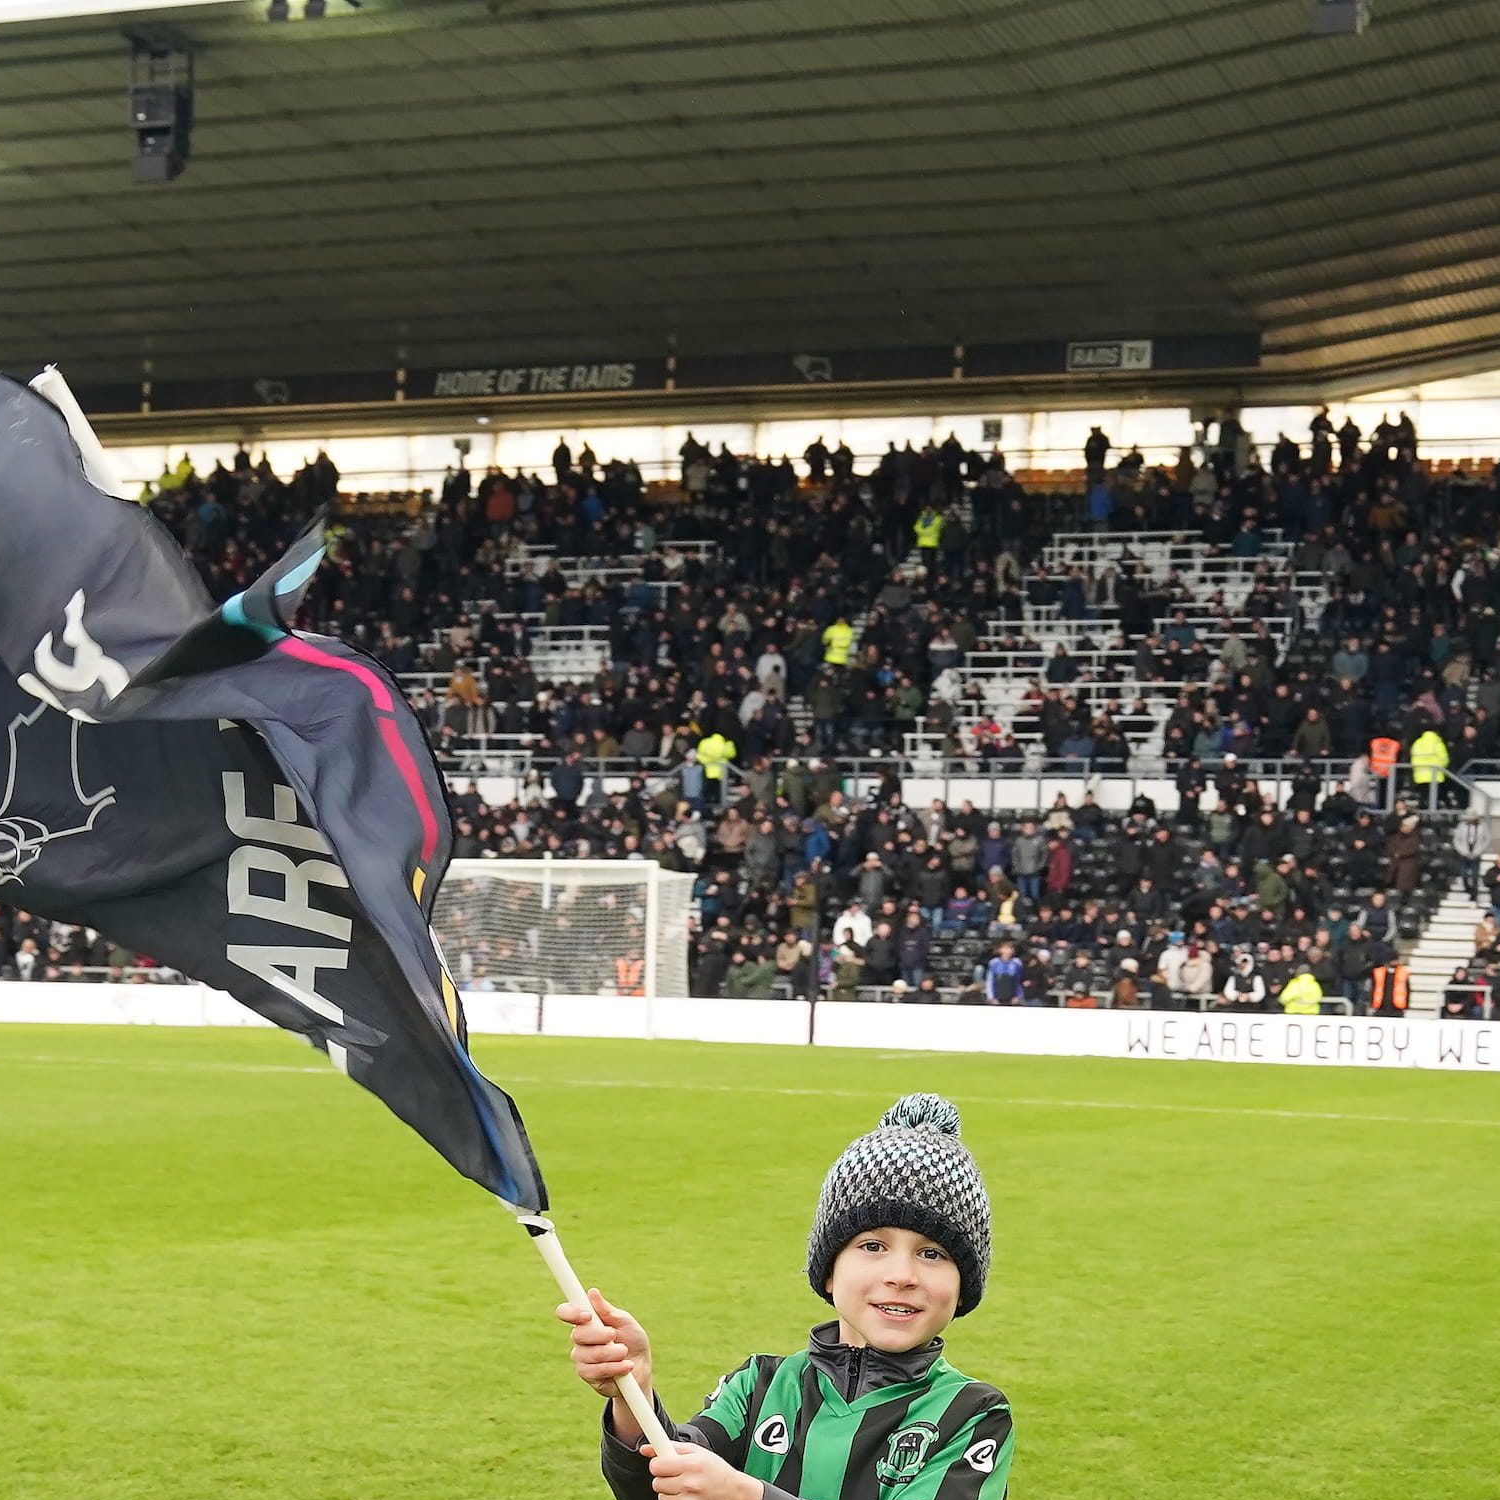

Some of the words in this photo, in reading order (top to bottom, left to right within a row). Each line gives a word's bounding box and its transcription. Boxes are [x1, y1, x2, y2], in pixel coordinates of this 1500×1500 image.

[434, 369, 498, 396] HOME
[498, 367, 527, 393] OF
[529, 365, 570, 392] THE
[570, 363, 636, 390] RAMS
[1127, 1018, 1177, 1055] WE
[1195, 1021, 1265, 1058] ARE
[1286, 1023, 1411, 1062] DERBY
[1439, 1027, 1493, 1066] WE
